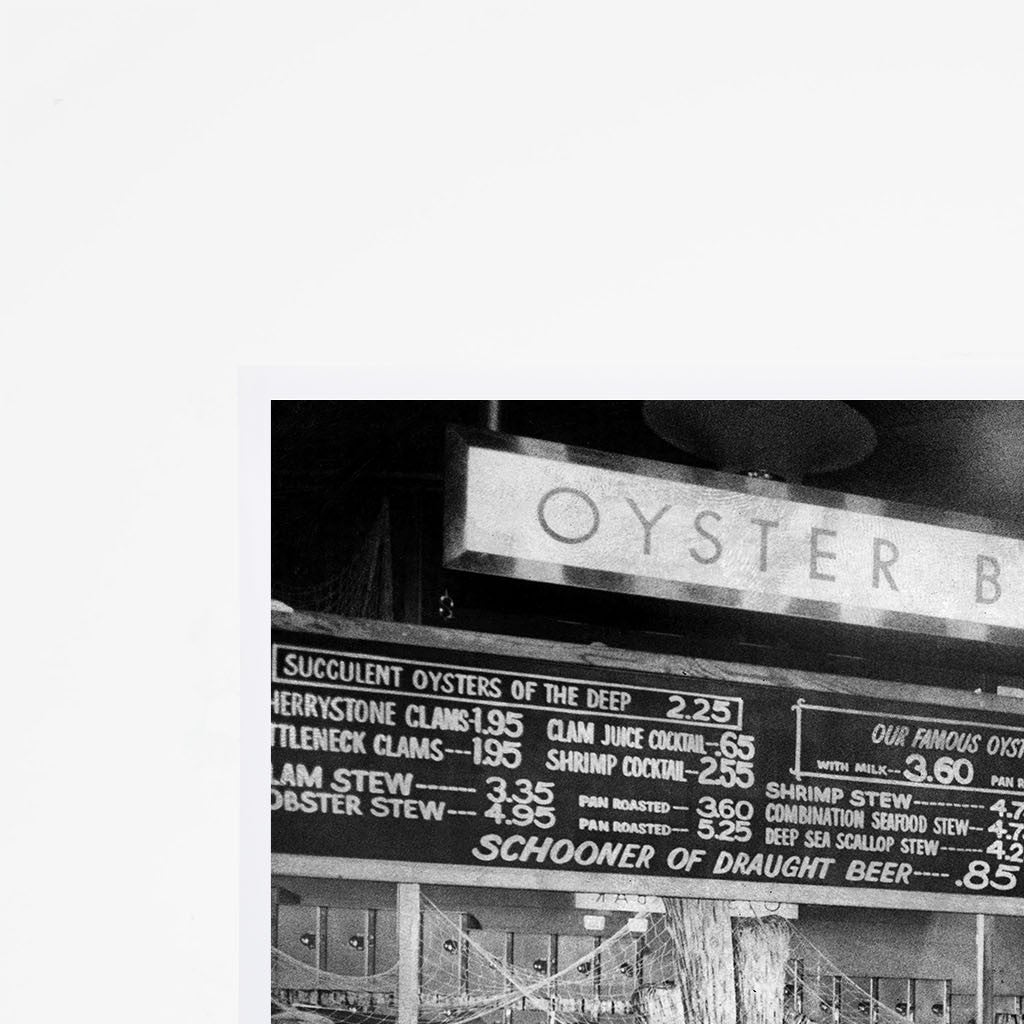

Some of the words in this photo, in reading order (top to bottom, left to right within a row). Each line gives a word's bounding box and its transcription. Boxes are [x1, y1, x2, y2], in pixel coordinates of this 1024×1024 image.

[537, 485, 900, 592] OYSTER
[283, 653, 403, 688] SUCCULENT
[412, 669, 502, 698] OYSTERS
[511, 680, 538, 701] OF
[543, 682, 579, 707] THE
[587, 688, 632, 712] DEEP
[666, 695, 731, 723] 2.25
[405, 704, 469, 732] CLAMS
[373, 734, 445, 761] CLAMS
[547, 718, 595, 744] CLAM
[601, 724, 645, 750] JUICE
[648, 730, 707, 755] COCKTAIL
[871, 723, 910, 747] OUR
[911, 728, 983, 754] FAMOUS
[545, 749, 618, 776] SHRIMP
[622, 755, 688, 783] COCKTAIL
[817, 759, 849, 773] WITH
[854, 763, 888, 776] MILK
[903, 753, 975, 785] 3.60
[990, 775, 1014, 789] PAN
[330, 768, 414, 796] STEW
[486, 776, 555, 805] 3.35
[765, 782, 844, 804] SHRIMP
[849, 790, 913, 810] STEW
[370, 797, 446, 821] STEW
[484, 802, 556, 829] 4.95
[578, 795, 609, 809] PAN
[612, 798, 671, 814] ROASTED
[765, 803, 865, 829] COMBINATION
[871, 811, 928, 834] SEAFOOD
[933, 817, 970, 837] STEW
[579, 818, 609, 832] PAN
[612, 821, 672, 836] ROASTED
[697, 819, 753, 842] 5.25
[765, 827, 799, 847] DEEP
[804, 830, 831, 849] SEA
[835, 832, 895, 852] SCALLOP
[900, 838, 939, 856] STEW
[471, 833, 656, 869] SCHOONER
[667, 847, 707, 872] OF
[713, 850, 836, 879] DRAUGHT
[845, 859, 913, 885] BEER
[955, 859, 1021, 891] .85
